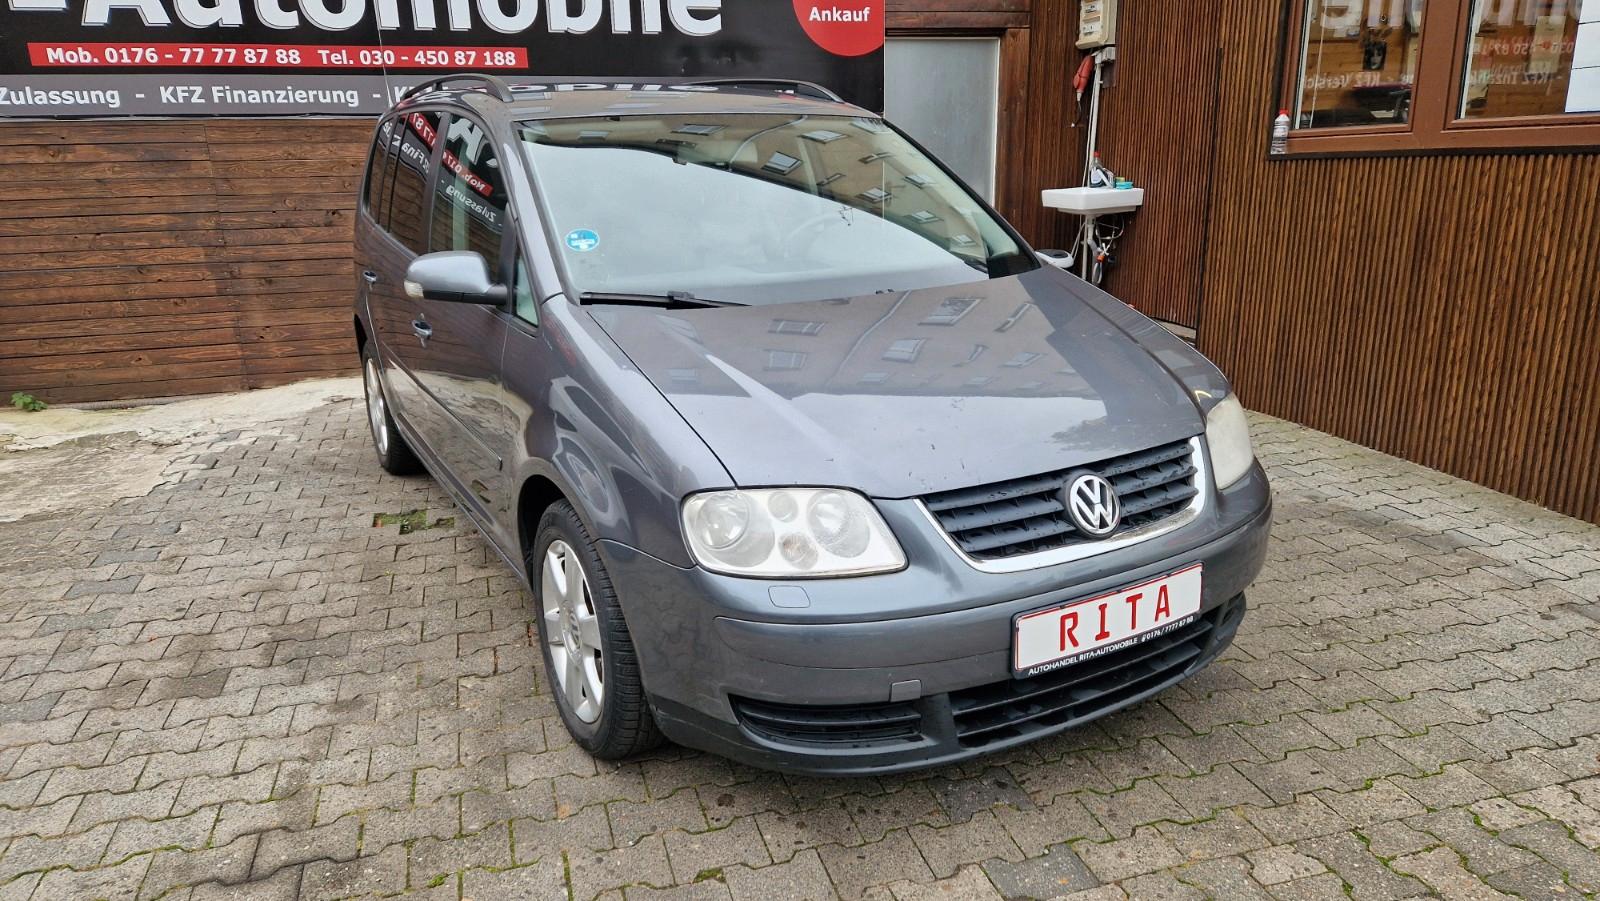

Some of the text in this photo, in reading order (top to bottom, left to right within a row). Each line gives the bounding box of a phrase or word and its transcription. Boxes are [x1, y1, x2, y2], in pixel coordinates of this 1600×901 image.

[808, 6, 871, 22] Ankauf
[46, 47, 99, 64] Mob.
[104, 48, 159, 63] 0176
[179, 48, 205, 63] 77
[211, 48, 237, 64] 77
[244, 48, 268, 64] 87
[275, 49, 301, 65] 88
[317, 49, 354, 65] Tel.
[359, 50, 395, 65] 030
[414, 51, 449, 65] 450
[454, 51, 477, 66] 87
[484, 51, 516, 66] 188
[0, 86, 121, 108] Zulassung
[160, 86, 206, 104] KFZ
[211, 86, 360, 107] Finanzierung
[1028, 655, 1079, 676] AUTOHANDEL
[1079, 637, 1138, 661] RITA-AUTOMOBILE
